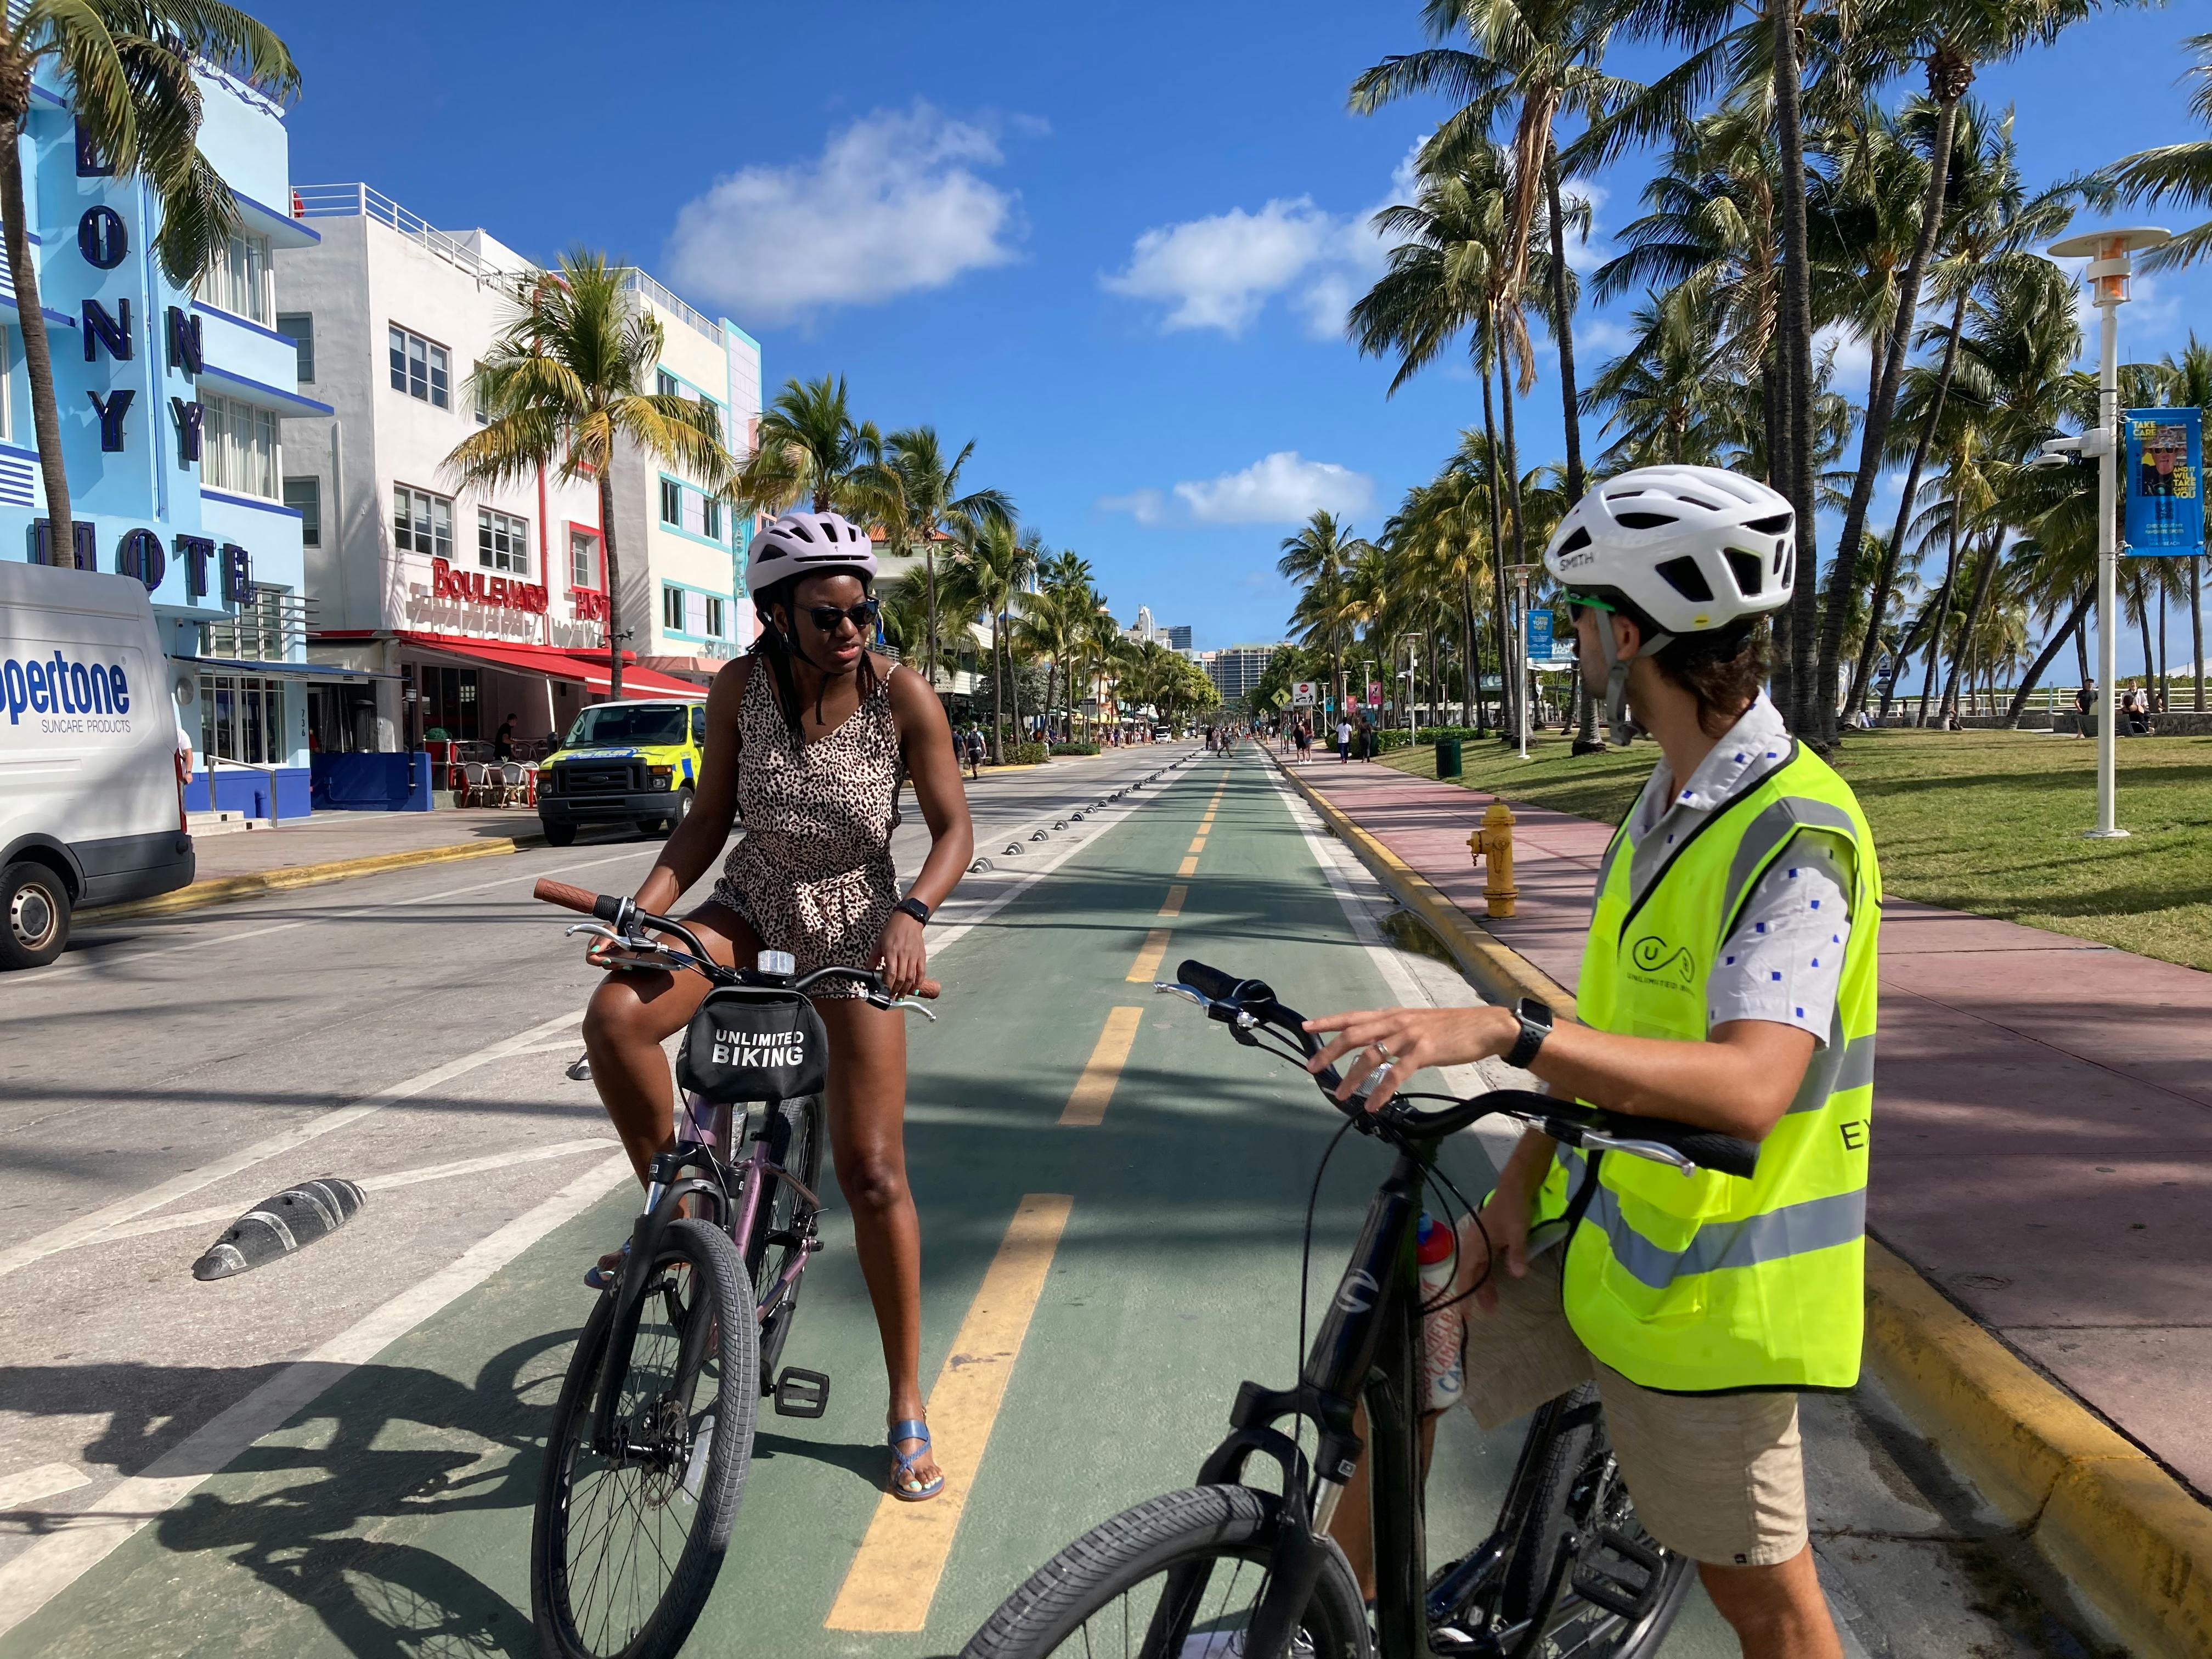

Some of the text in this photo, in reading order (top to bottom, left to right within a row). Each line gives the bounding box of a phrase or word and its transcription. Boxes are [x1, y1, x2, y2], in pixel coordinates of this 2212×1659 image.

[1560, 552, 1594, 571] SMITH
[431, 557, 548, 615] BOULEVARD
[42, 719, 131, 733] SUNCARE PRODUCTS
[716, 1029, 804, 1047] UNLIMITED
[712, 1043, 804, 1068] BIKING
